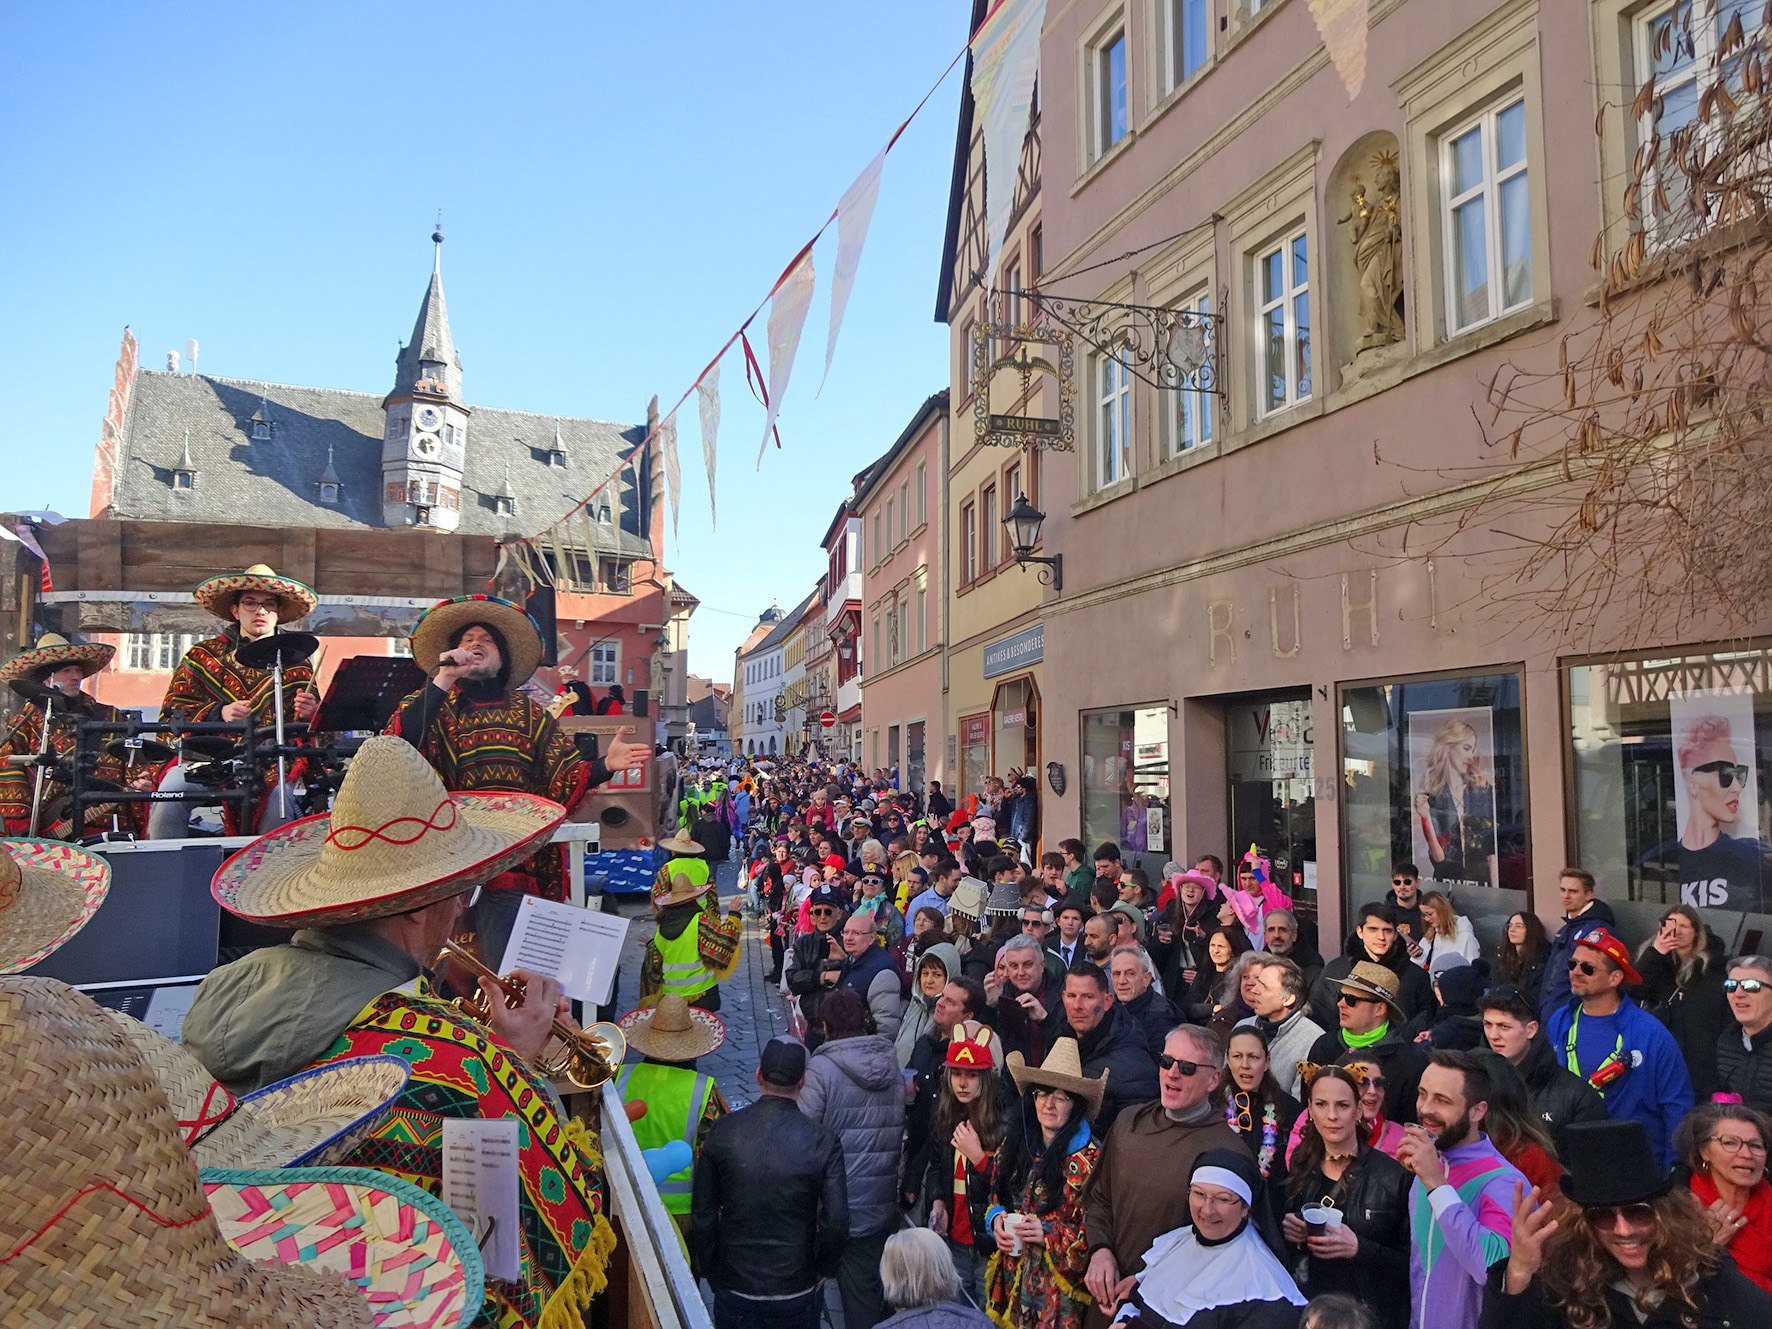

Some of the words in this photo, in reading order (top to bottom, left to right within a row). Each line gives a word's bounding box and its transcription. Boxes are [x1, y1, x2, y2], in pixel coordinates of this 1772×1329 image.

[1007, 418, 1042, 432] RUHL
[986, 651, 1006, 666] ANTIKES
[1011, 635, 1044, 657] BESONDERES
[151, 791, 184, 799] Roland
[1315, 776, 1336, 801] 25
[1681, 878, 1728, 908] KIS
[955, 1046, 974, 1064] A
